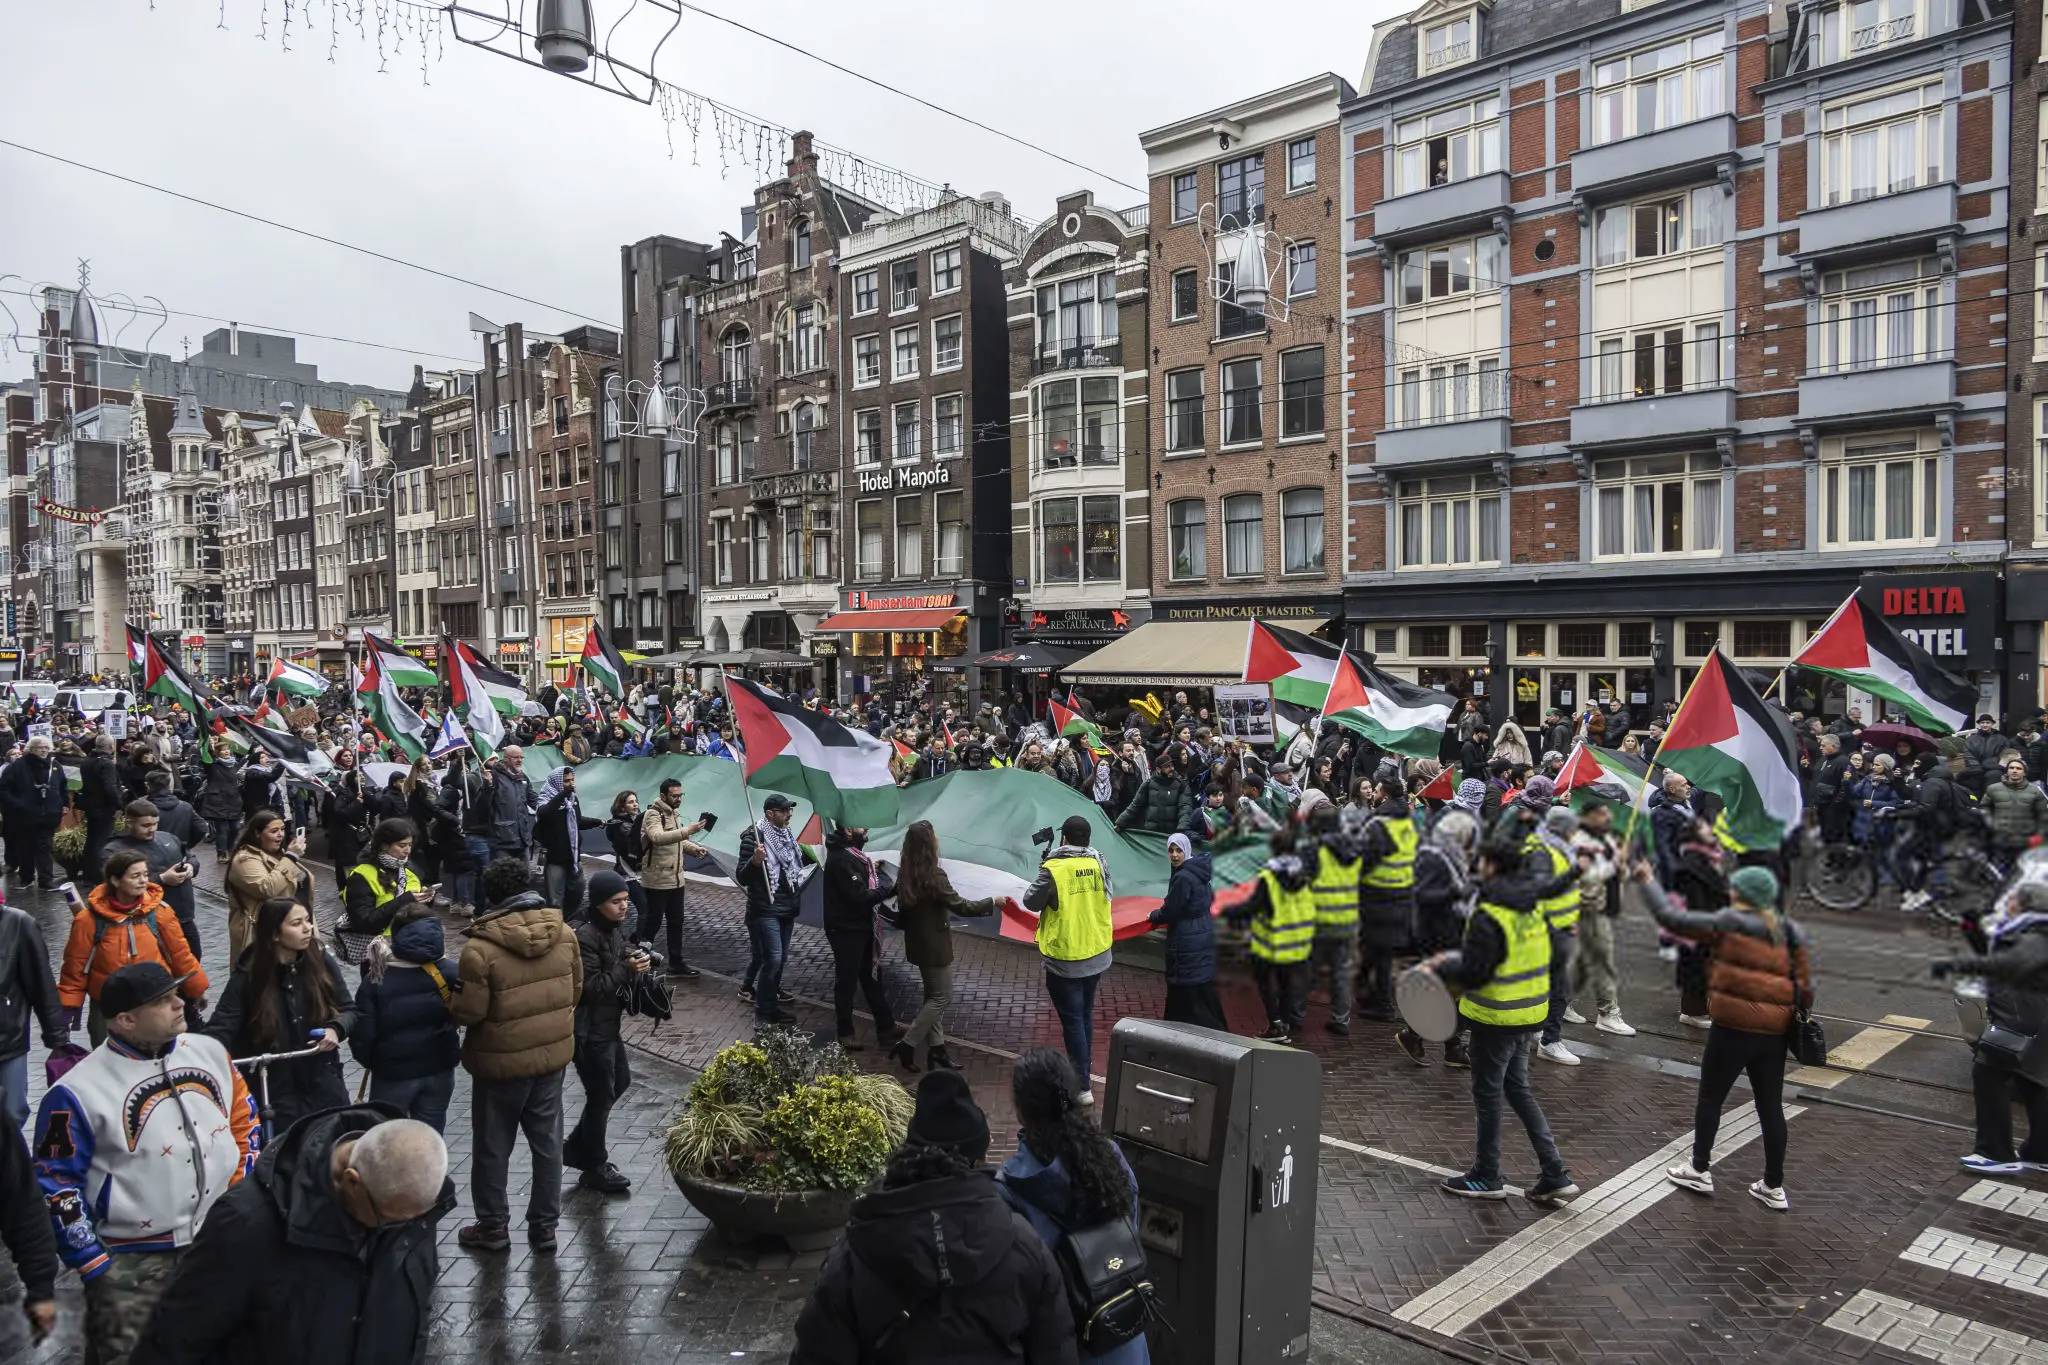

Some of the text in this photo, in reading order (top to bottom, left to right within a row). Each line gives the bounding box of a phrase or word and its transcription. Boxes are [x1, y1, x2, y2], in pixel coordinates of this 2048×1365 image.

[860, 468, 892, 492] Hotel
[44, 503, 101, 522] CASINO
[1883, 587, 1966, 615] DELTA
[1064, 610, 1090, 620] GRILL
[1206, 606, 1264, 618] PANCAKE
[1265, 606, 1315, 616] MASTERS
[1051, 620, 1106, 630] RESTAURANT
[1150, 677, 1177, 685] DINNER
[2017, 672, 2030, 681] 41
